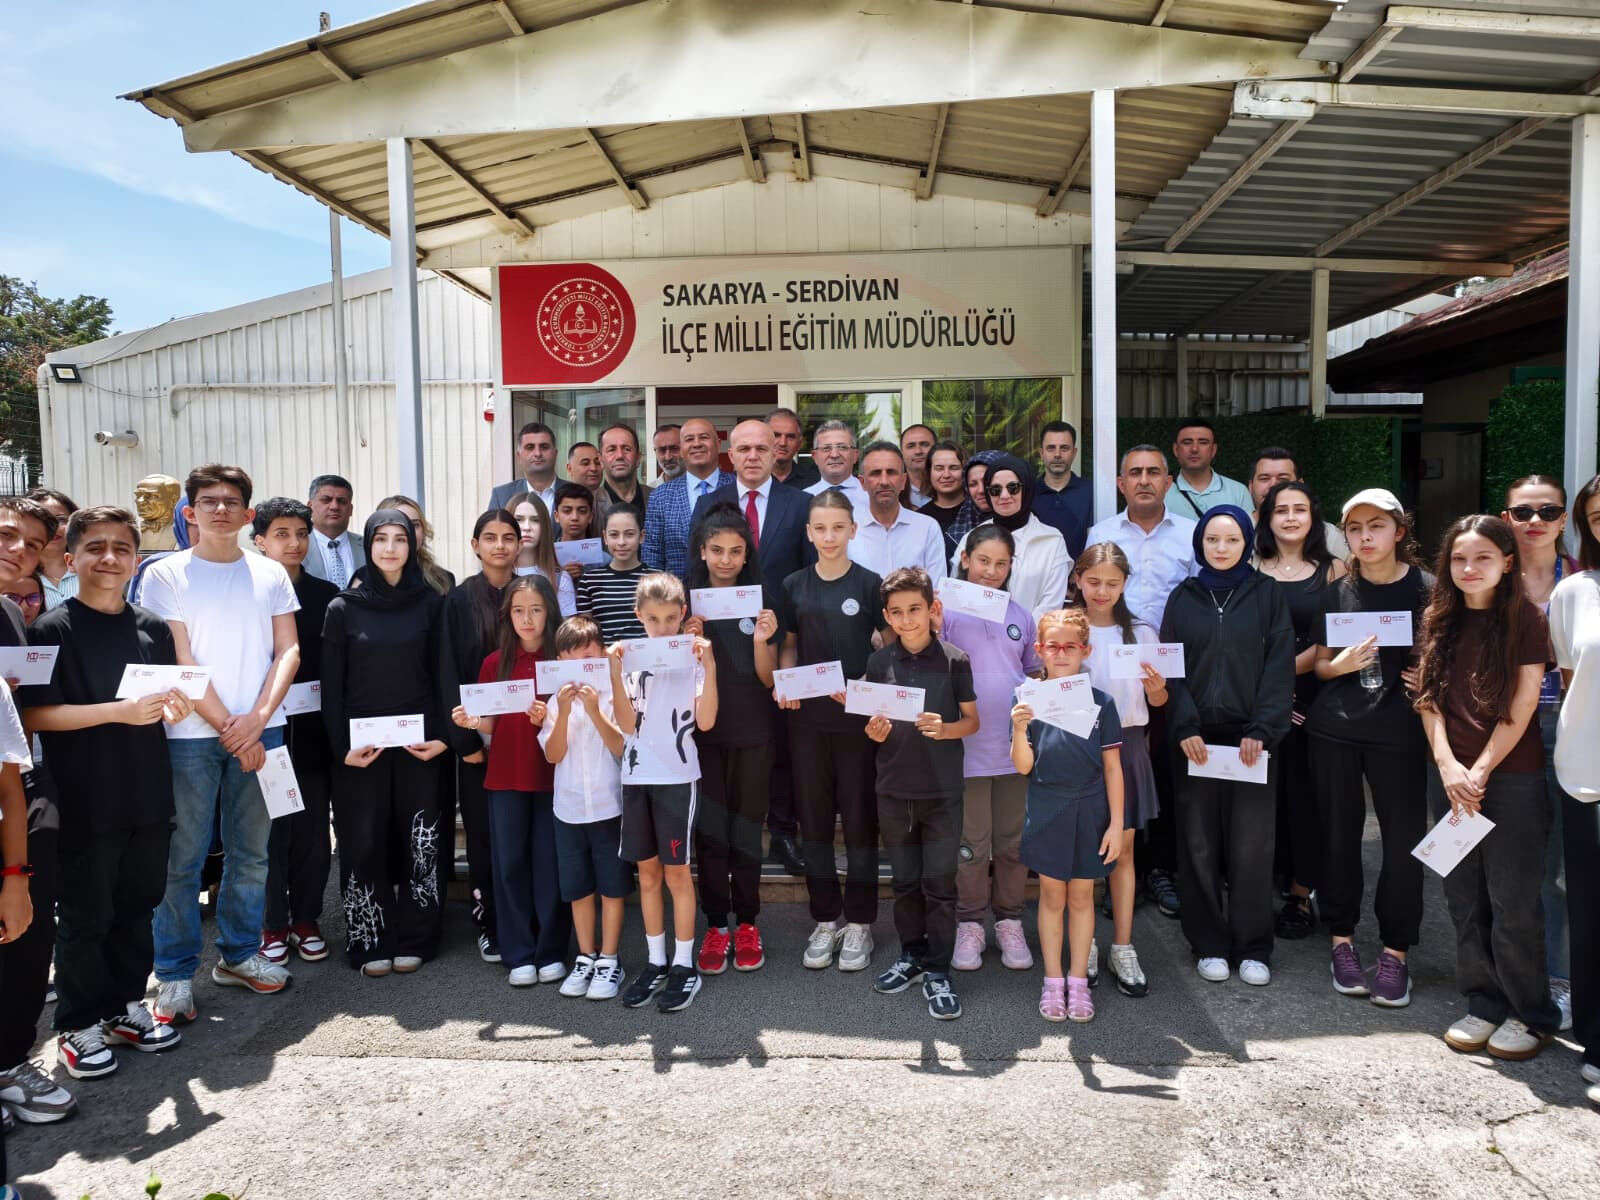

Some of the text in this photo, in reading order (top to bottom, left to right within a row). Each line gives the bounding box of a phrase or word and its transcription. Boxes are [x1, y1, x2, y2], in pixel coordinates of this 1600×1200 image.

[662, 281, 767, 307] SAKARYA
[785, 273, 899, 304] SERDİVAN
[662, 307, 1016, 363] İLÇE MİLLİ EĞİTİM MÜDÜRLÜĞÜ
